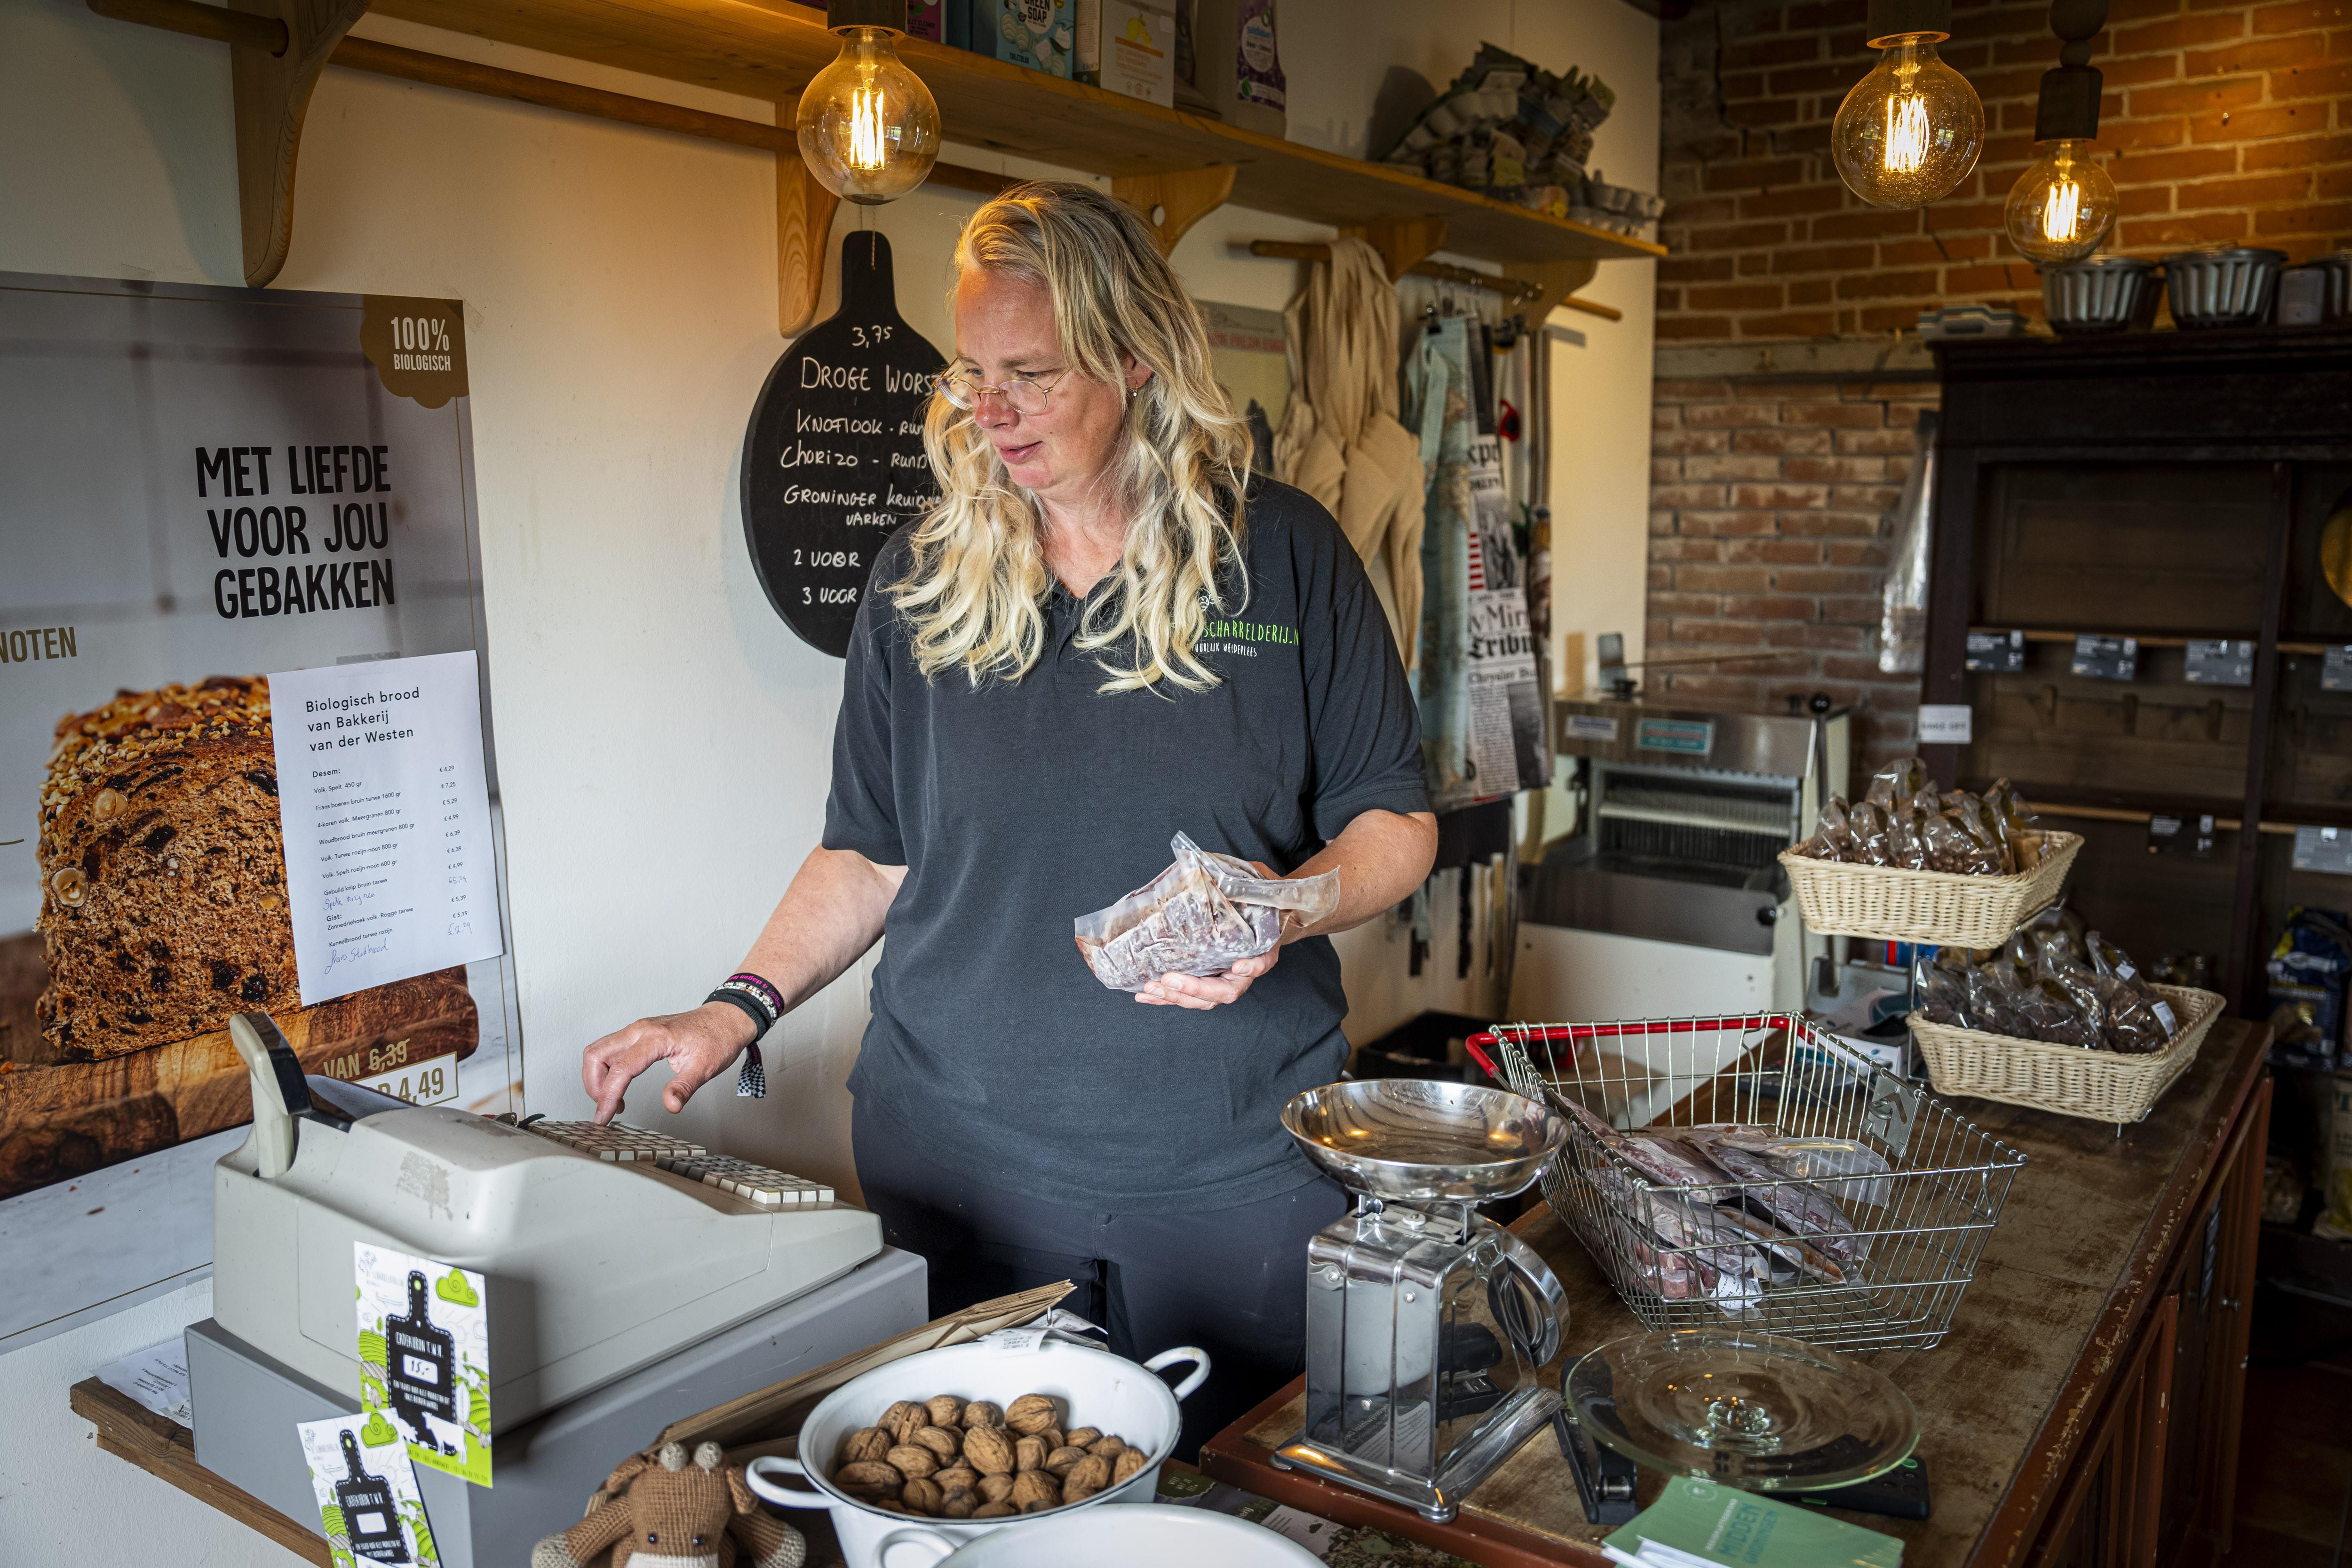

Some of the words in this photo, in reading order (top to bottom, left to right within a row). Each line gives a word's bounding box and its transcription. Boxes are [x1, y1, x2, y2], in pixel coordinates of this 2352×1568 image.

[1028, 7, 1047, 23] SOAP
[391, 318, 450, 352] 100%
[852, 326, 893, 348] 3,75
[393, 353, 451, 372] BIOLOGISCH
[801, 357, 871, 391] DROGE
[195, 446, 272, 498] MET
[288, 445, 391, 495] LIEFDE
[784, 485, 877, 505] GRONINGER
[846, 514, 897, 526] VARKEN
[207, 506, 311, 558] VOOR
[324, 502, 389, 553] JOU
[794, 549, 802, 565] 2
[810, 552, 860, 567] VOOR
[214, 558, 395, 619] GEBAKKEN
[803, 587, 812, 604] 3
[819, 588, 857, 604] VOOR
[1224, 643, 1257, 657] WEIDEVLEES
[306, 692, 375, 713] Biologisch
[380, 687, 420, 702] brood
[308, 722, 331, 732] van
[336, 710, 389, 728] Bakkerij
[310, 741, 333, 751] van
[339, 735, 360, 748] der
[365, 728, 414, 743] Westen
[312, 767, 341, 778] Desem:
[352, 811, 384, 822] Meergranen
[319, 834, 350, 845] Woudbrood
[366, 826, 397, 836] meergranen
[352, 845, 381, 858] rozijn-noot
[336, 868, 350, 876] Spelt
[351, 862, 380, 873] rozijn-noot
[324, 887, 344, 896] Gebuild
[326, 913, 342, 922] Gist:
[327, 917, 366, 931] Zonnedriehoek
[380, 911, 397, 920] Rogge
[329, 934, 362, 947] Kaneelbrood
[380, 928, 393, 936] rozijn
[740, 974, 763, 985] dagen
[324, 1052, 360, 1079] VAN
[369, 1041, 408, 1071] 6,39
[398, 1067, 444, 1104] 4,49
[395, 1331, 426, 1353] CADEAUBON
